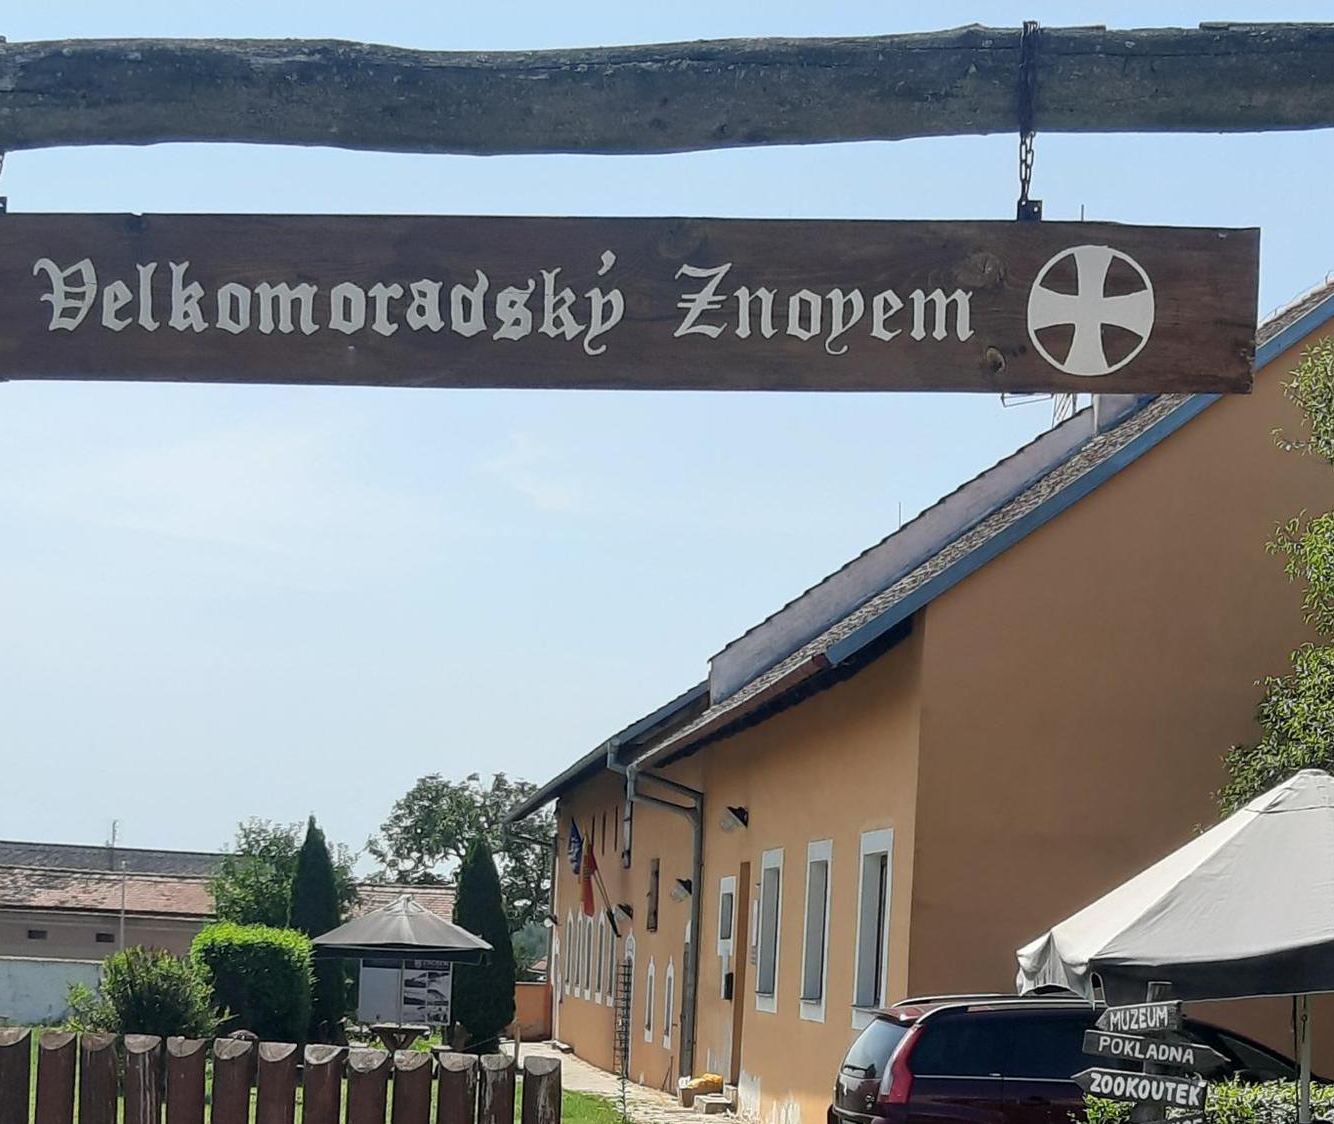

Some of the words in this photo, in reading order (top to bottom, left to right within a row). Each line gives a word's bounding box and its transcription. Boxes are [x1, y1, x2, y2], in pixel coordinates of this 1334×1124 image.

[1109, 1004, 1169, 1032] MUZEUM
[1098, 1035, 1195, 1065] POKLADNA
[1089, 1072, 1201, 1106] ZOOKOUTEK
